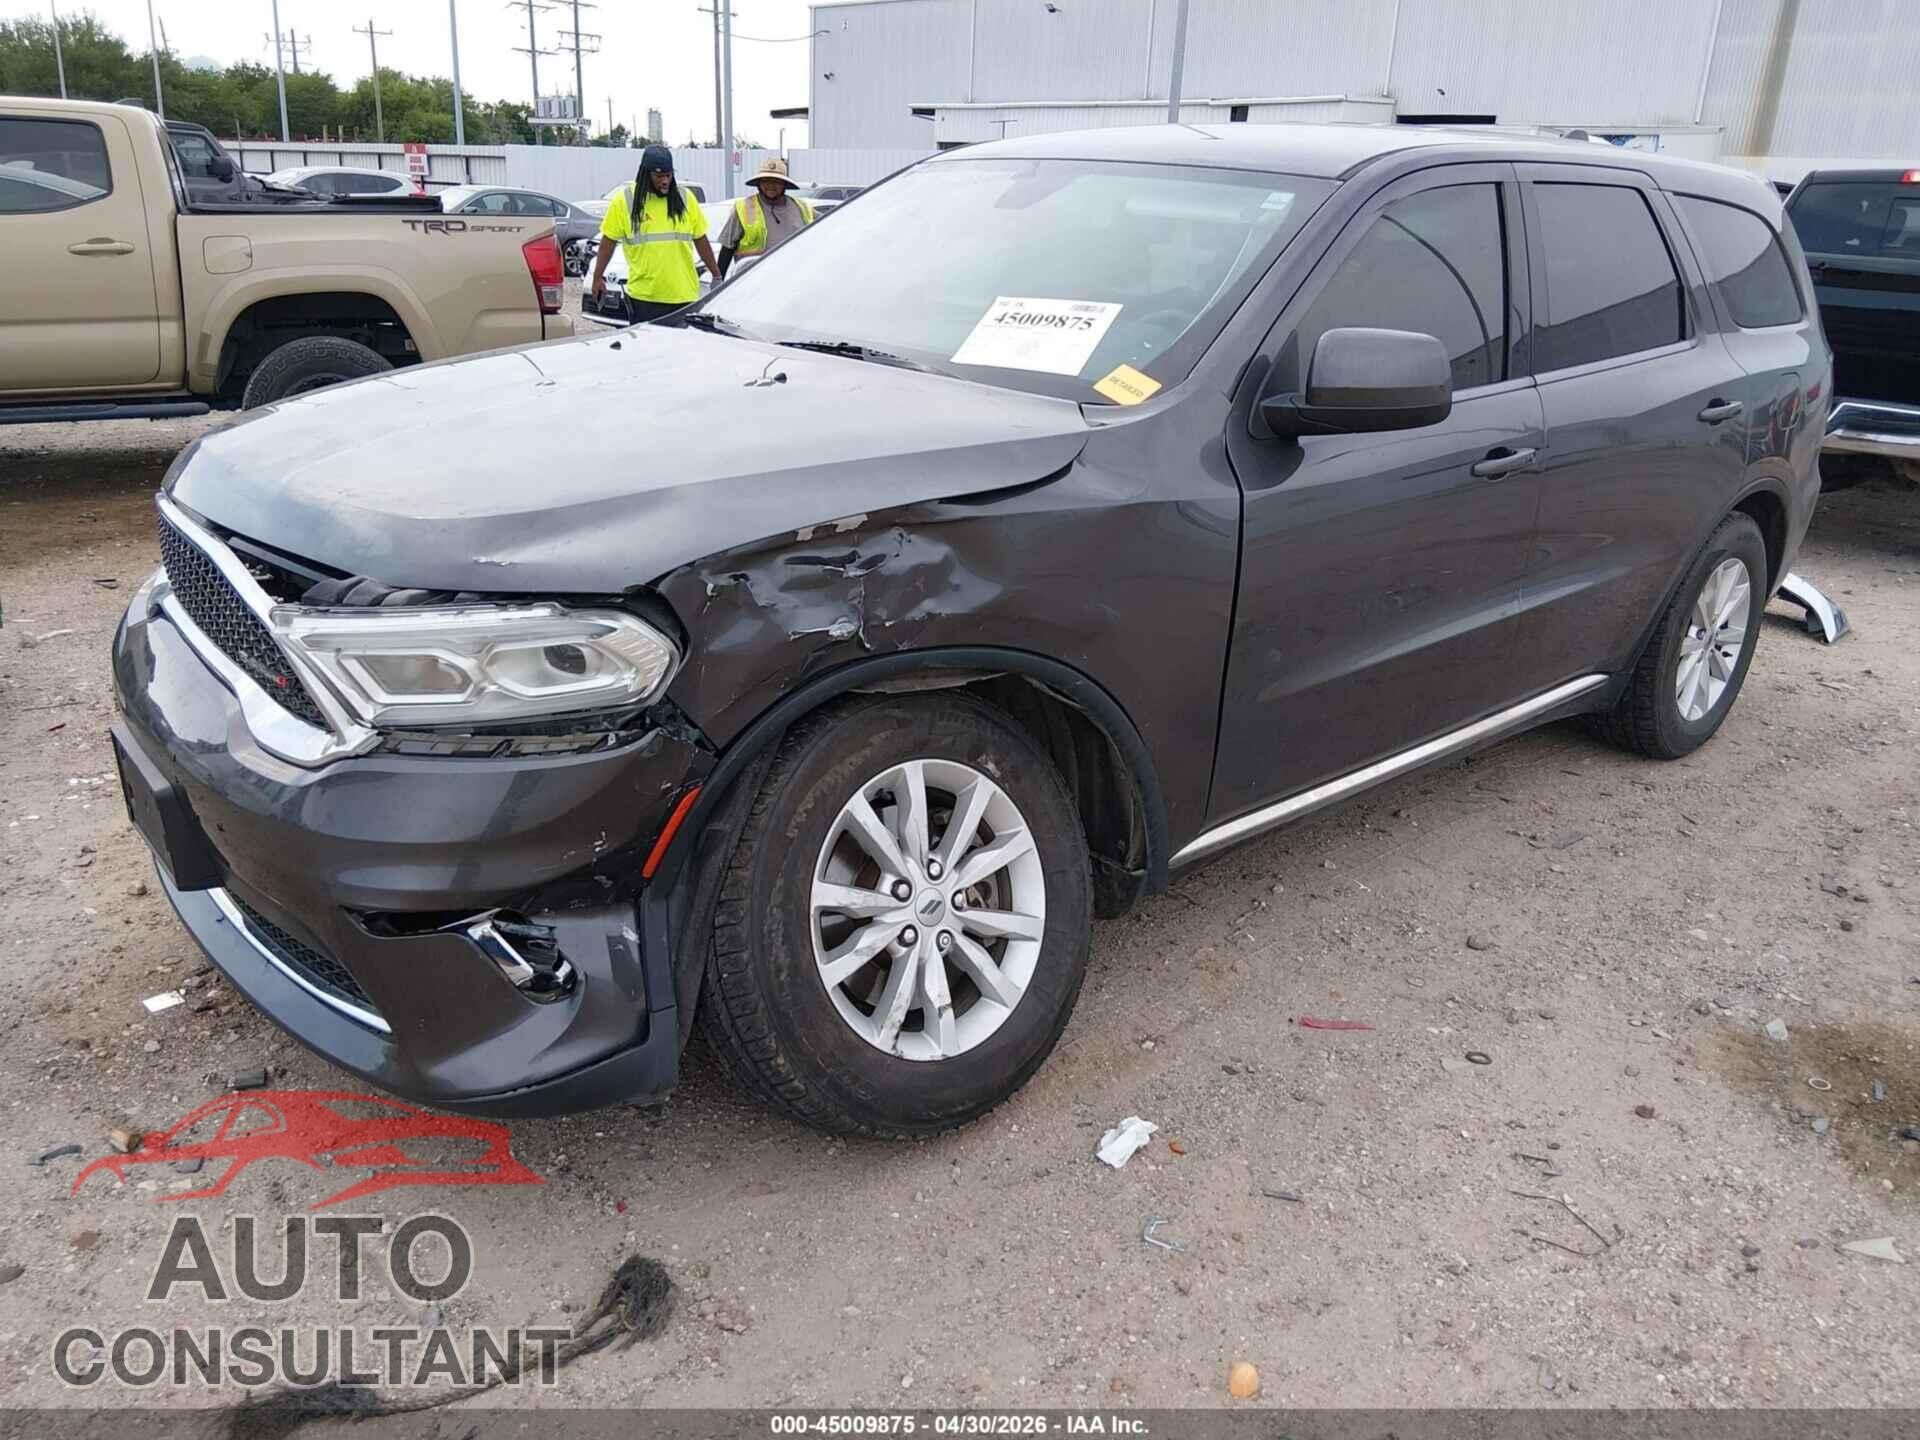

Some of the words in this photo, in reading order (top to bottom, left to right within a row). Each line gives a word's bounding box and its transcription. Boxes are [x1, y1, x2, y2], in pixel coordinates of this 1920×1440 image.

[401, 219, 467, 236] TRD
[470, 225, 526, 233] SPORT
[994, 311, 1095, 331] 45009875
